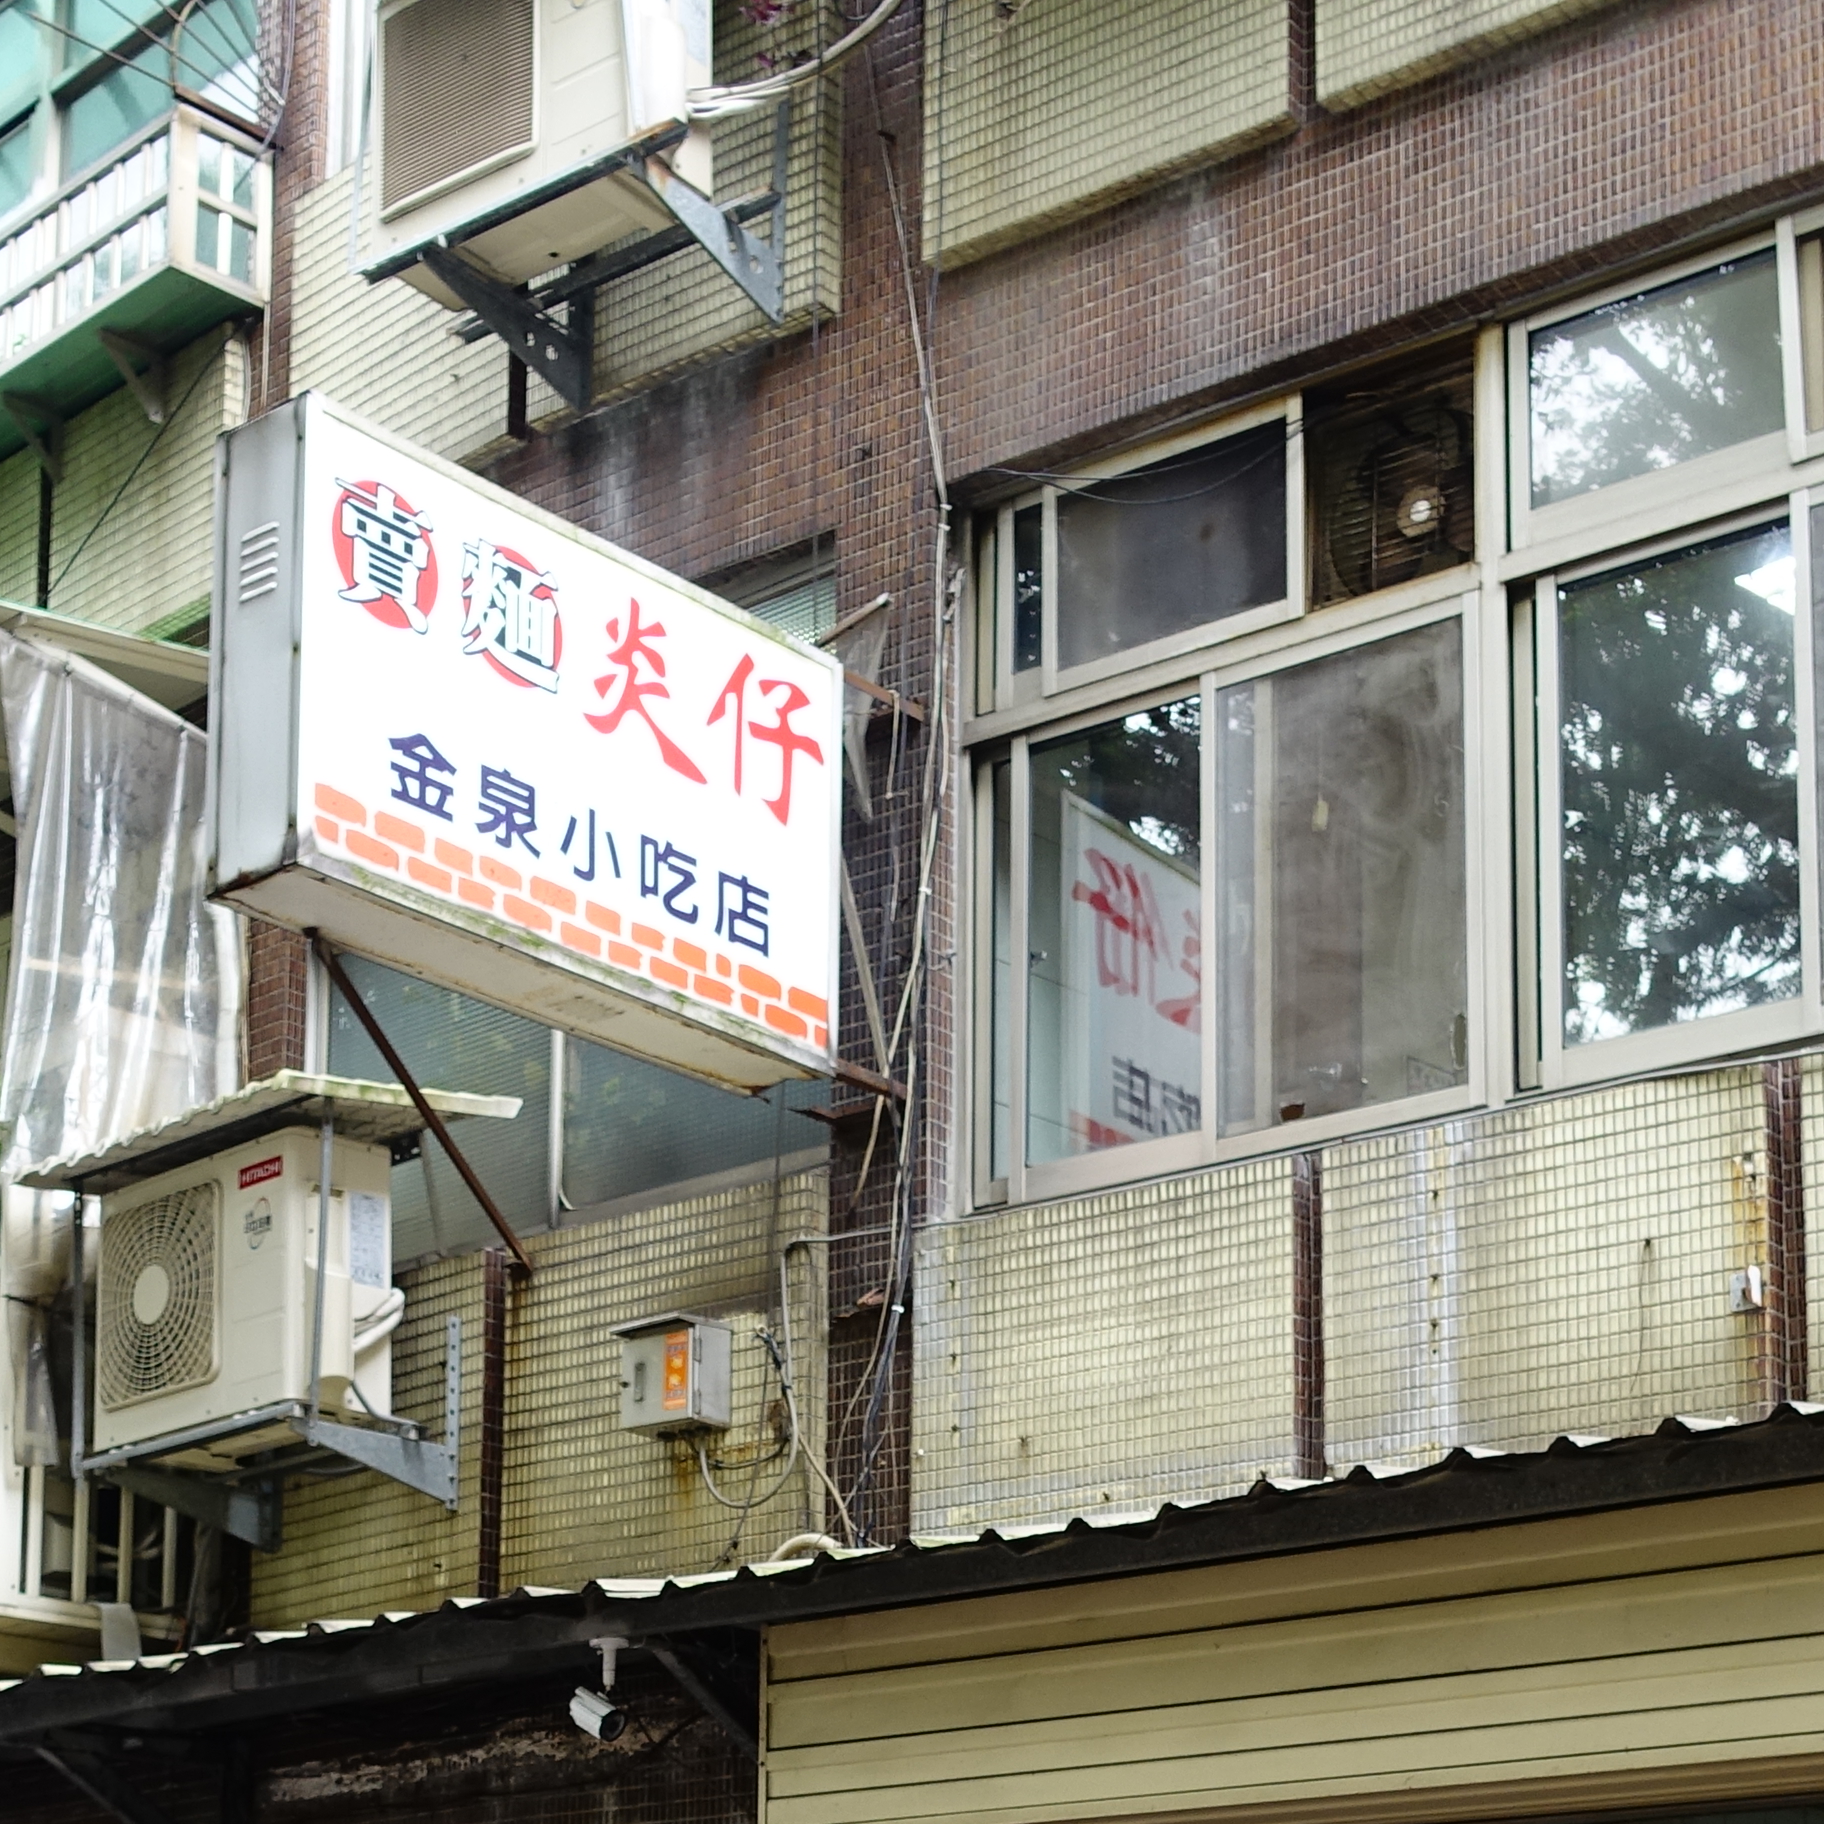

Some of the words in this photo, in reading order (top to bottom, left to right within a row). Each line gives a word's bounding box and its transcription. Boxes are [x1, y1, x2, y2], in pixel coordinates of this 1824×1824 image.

[388, 733, 771, 957] 金泉小吃店
[241, 1161, 279, 1186] HITACHI
